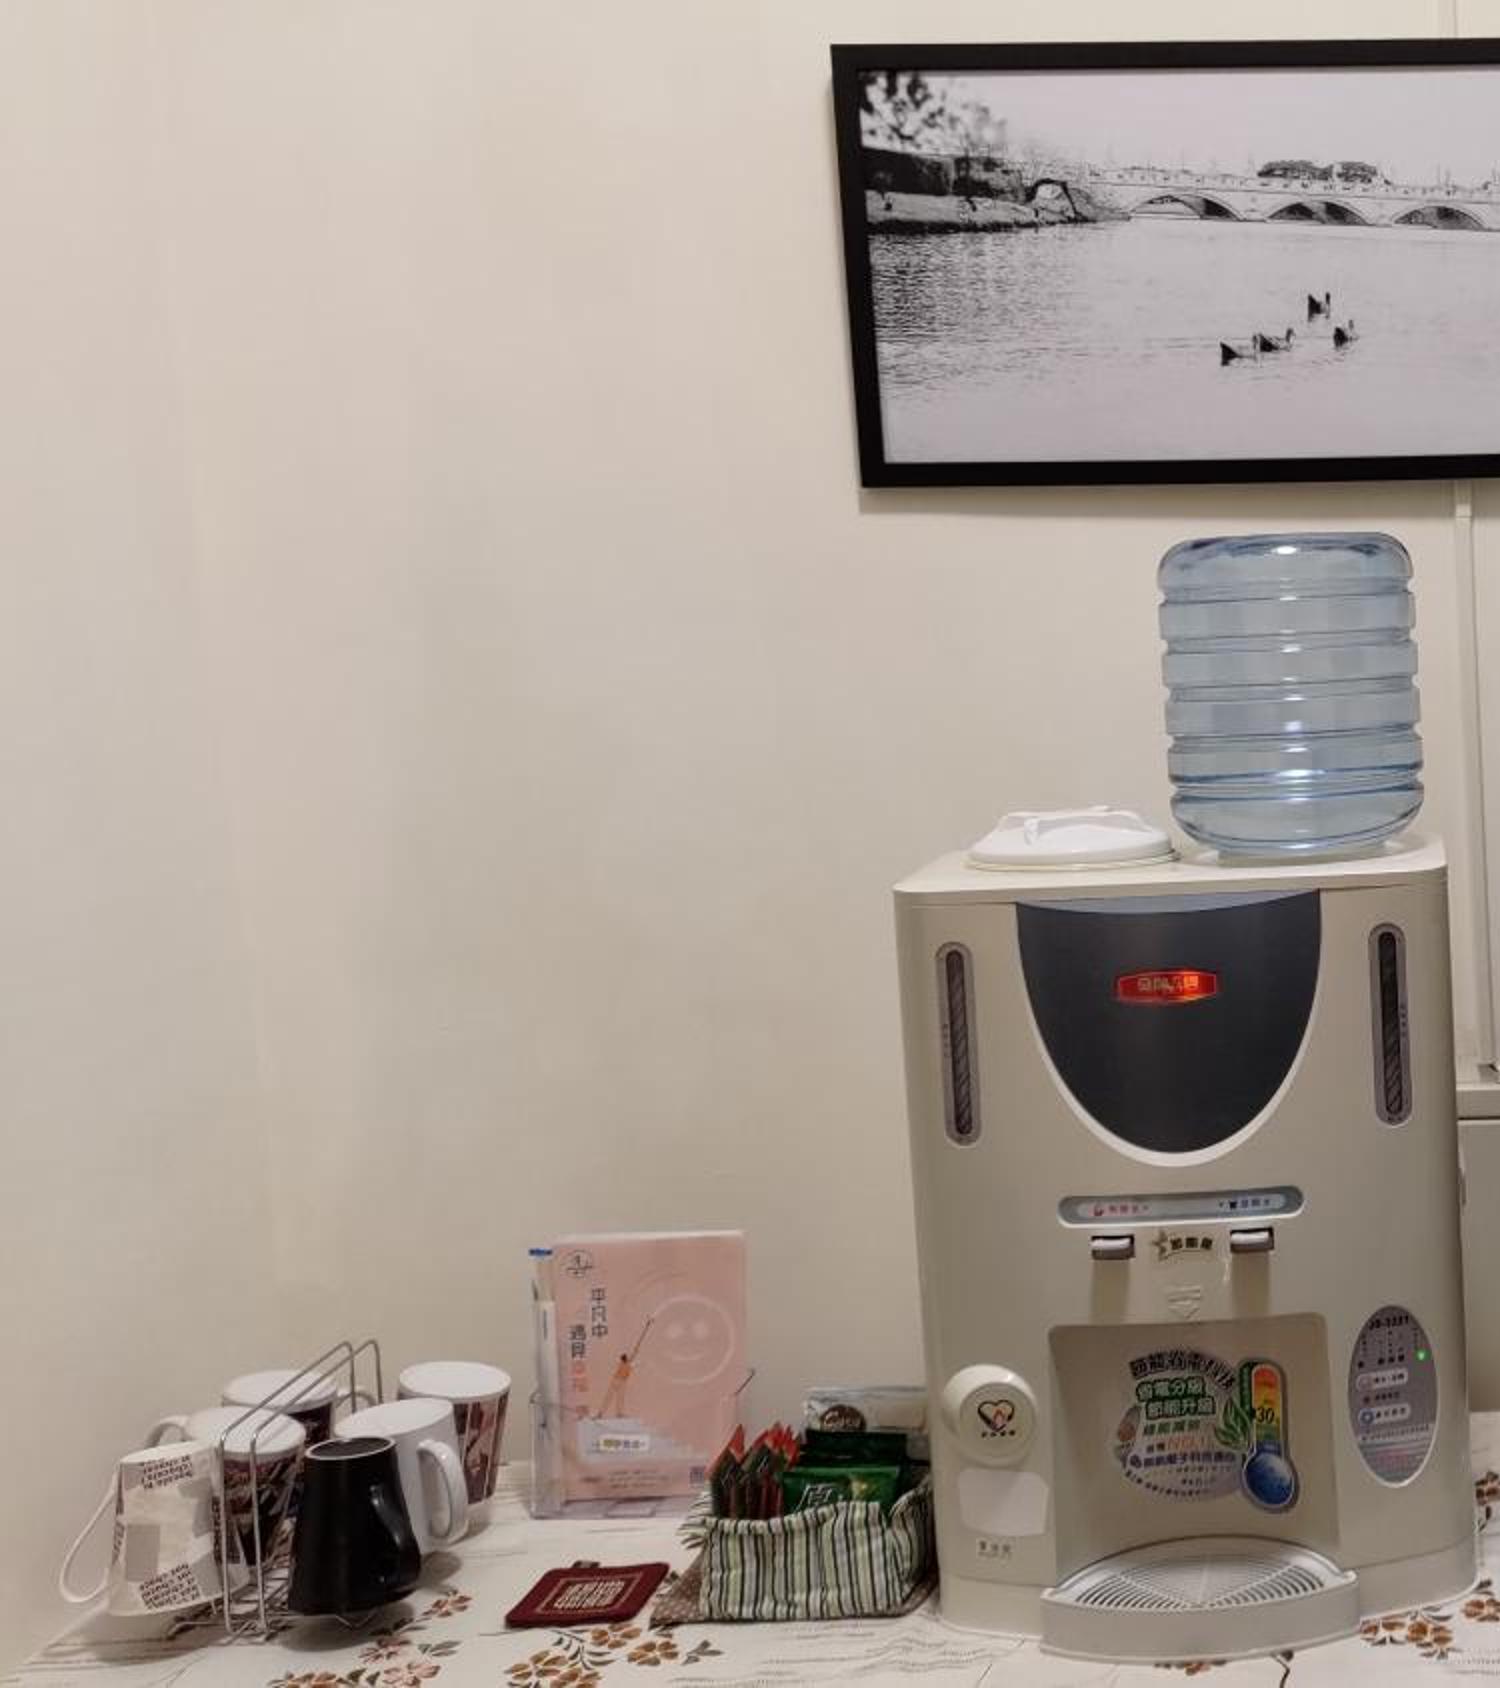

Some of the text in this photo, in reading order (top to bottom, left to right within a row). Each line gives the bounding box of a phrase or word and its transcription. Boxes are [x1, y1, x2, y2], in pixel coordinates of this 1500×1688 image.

[591, 1287, 609, 1339] 平凡中
[1256, 1407, 1275, 1424] 30
